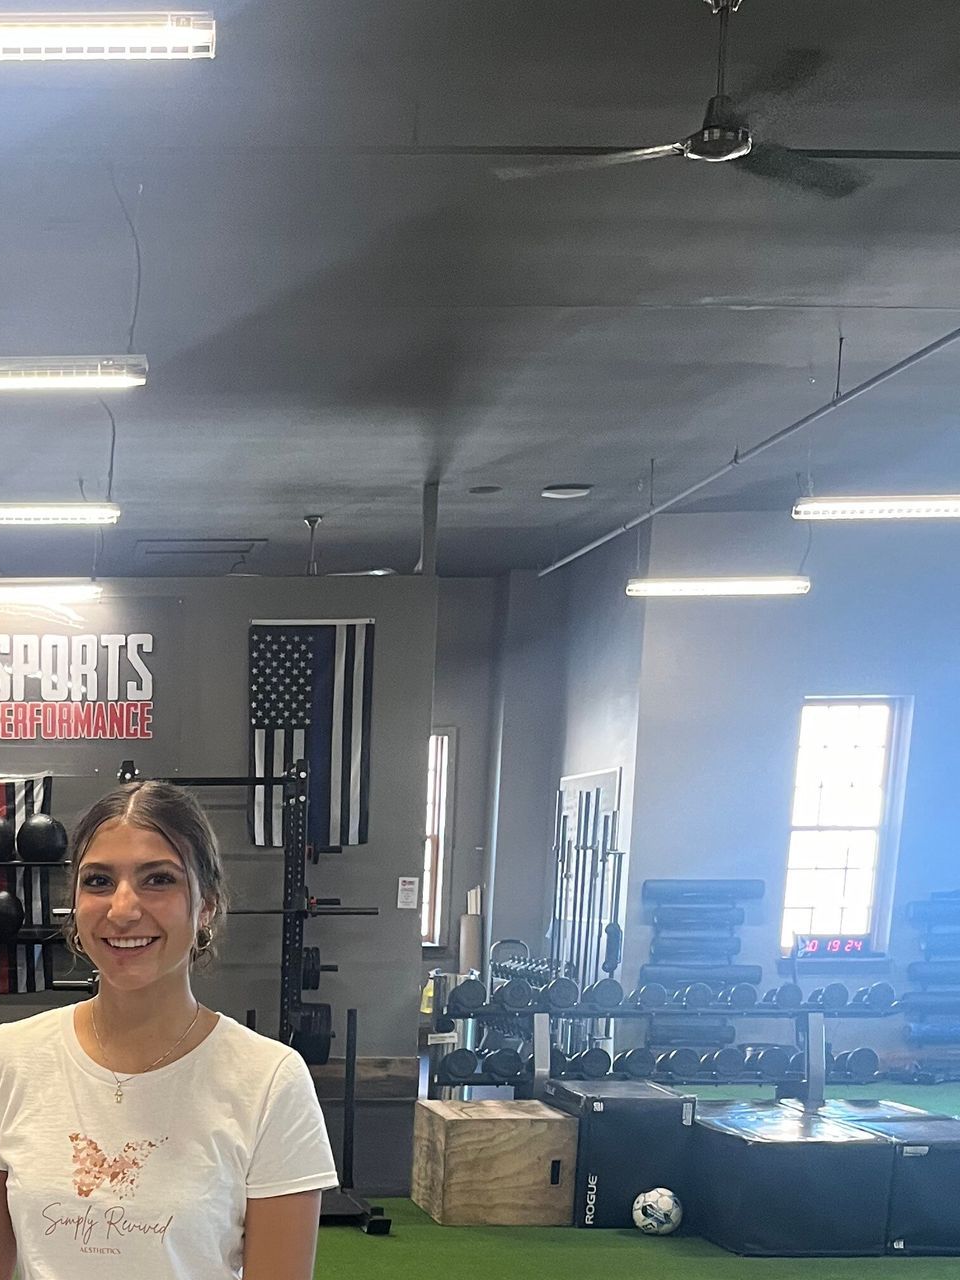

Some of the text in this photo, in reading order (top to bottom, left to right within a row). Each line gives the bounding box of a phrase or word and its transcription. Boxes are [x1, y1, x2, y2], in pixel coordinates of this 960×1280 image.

[844, 939, 863, 952] 24
[585, 1174, 598, 1225] ROGUE
[41, 1202, 174, 1245] Simply Revived
[79, 1246, 121, 1255] AESTHETICS
